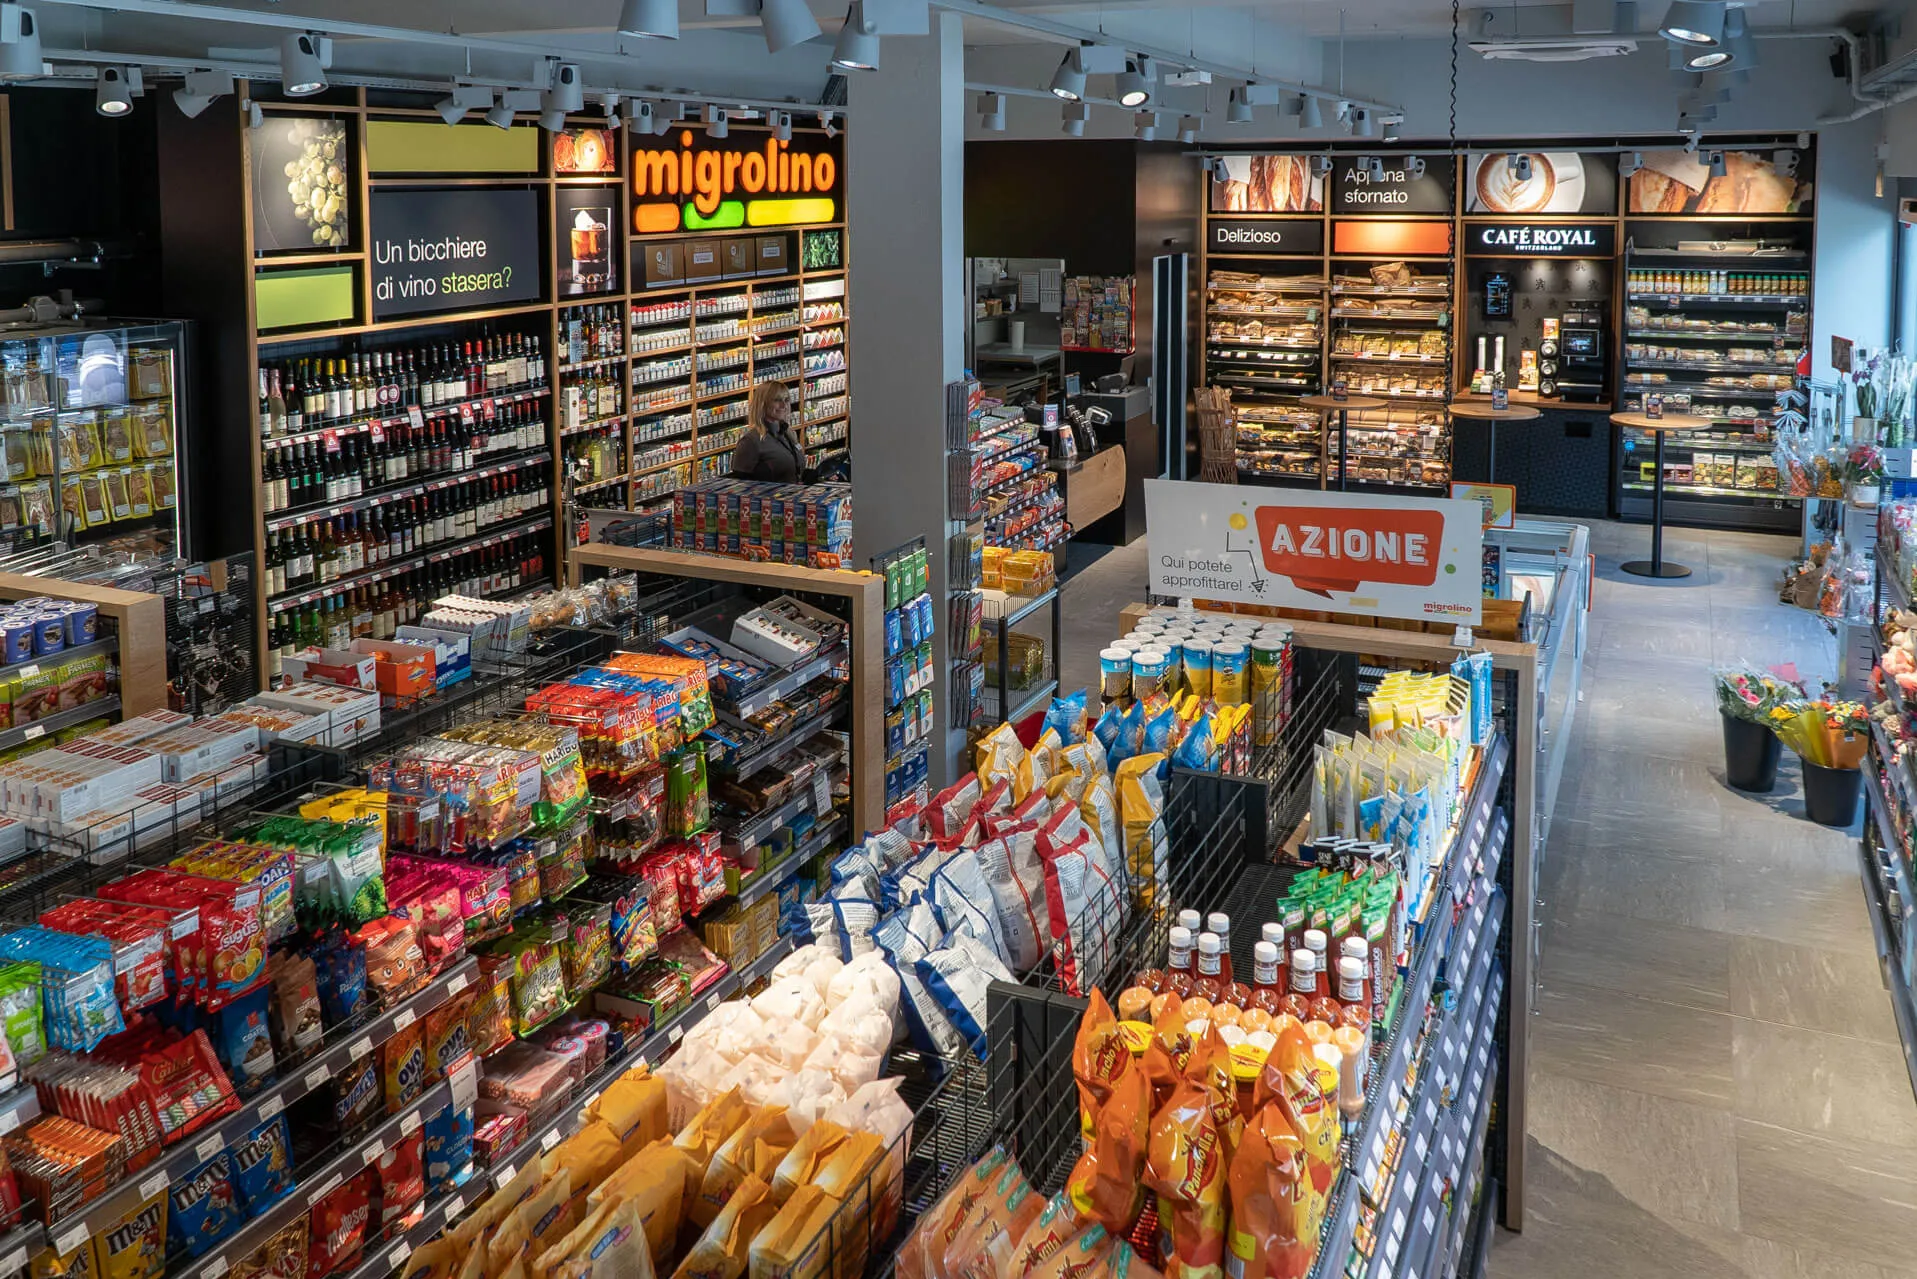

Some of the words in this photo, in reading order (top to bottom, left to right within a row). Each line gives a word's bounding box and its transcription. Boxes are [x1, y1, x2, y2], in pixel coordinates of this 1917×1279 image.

[635, 129, 836, 214] migrolino
[1344, 188, 1408, 204] sfornato
[1216, 227, 1282, 244] Delizioso
[1482, 227, 1531, 245] CAFÉ
[1533, 229, 1596, 246] ROYAL
[375, 239, 403, 264] Un
[408, 236, 488, 262] bicchiere
[376, 275, 393, 301] di
[399, 274, 437, 298] vino
[441, 266, 513, 294] stasera?
[1271, 523, 1429, 567] AZIONE
[1161, 555, 1184, 569] Qui
[1188, 559, 1233, 573] potete
[1161, 575, 1243, 592] approfittare!
[1423, 602, 1473, 613] migrolino
